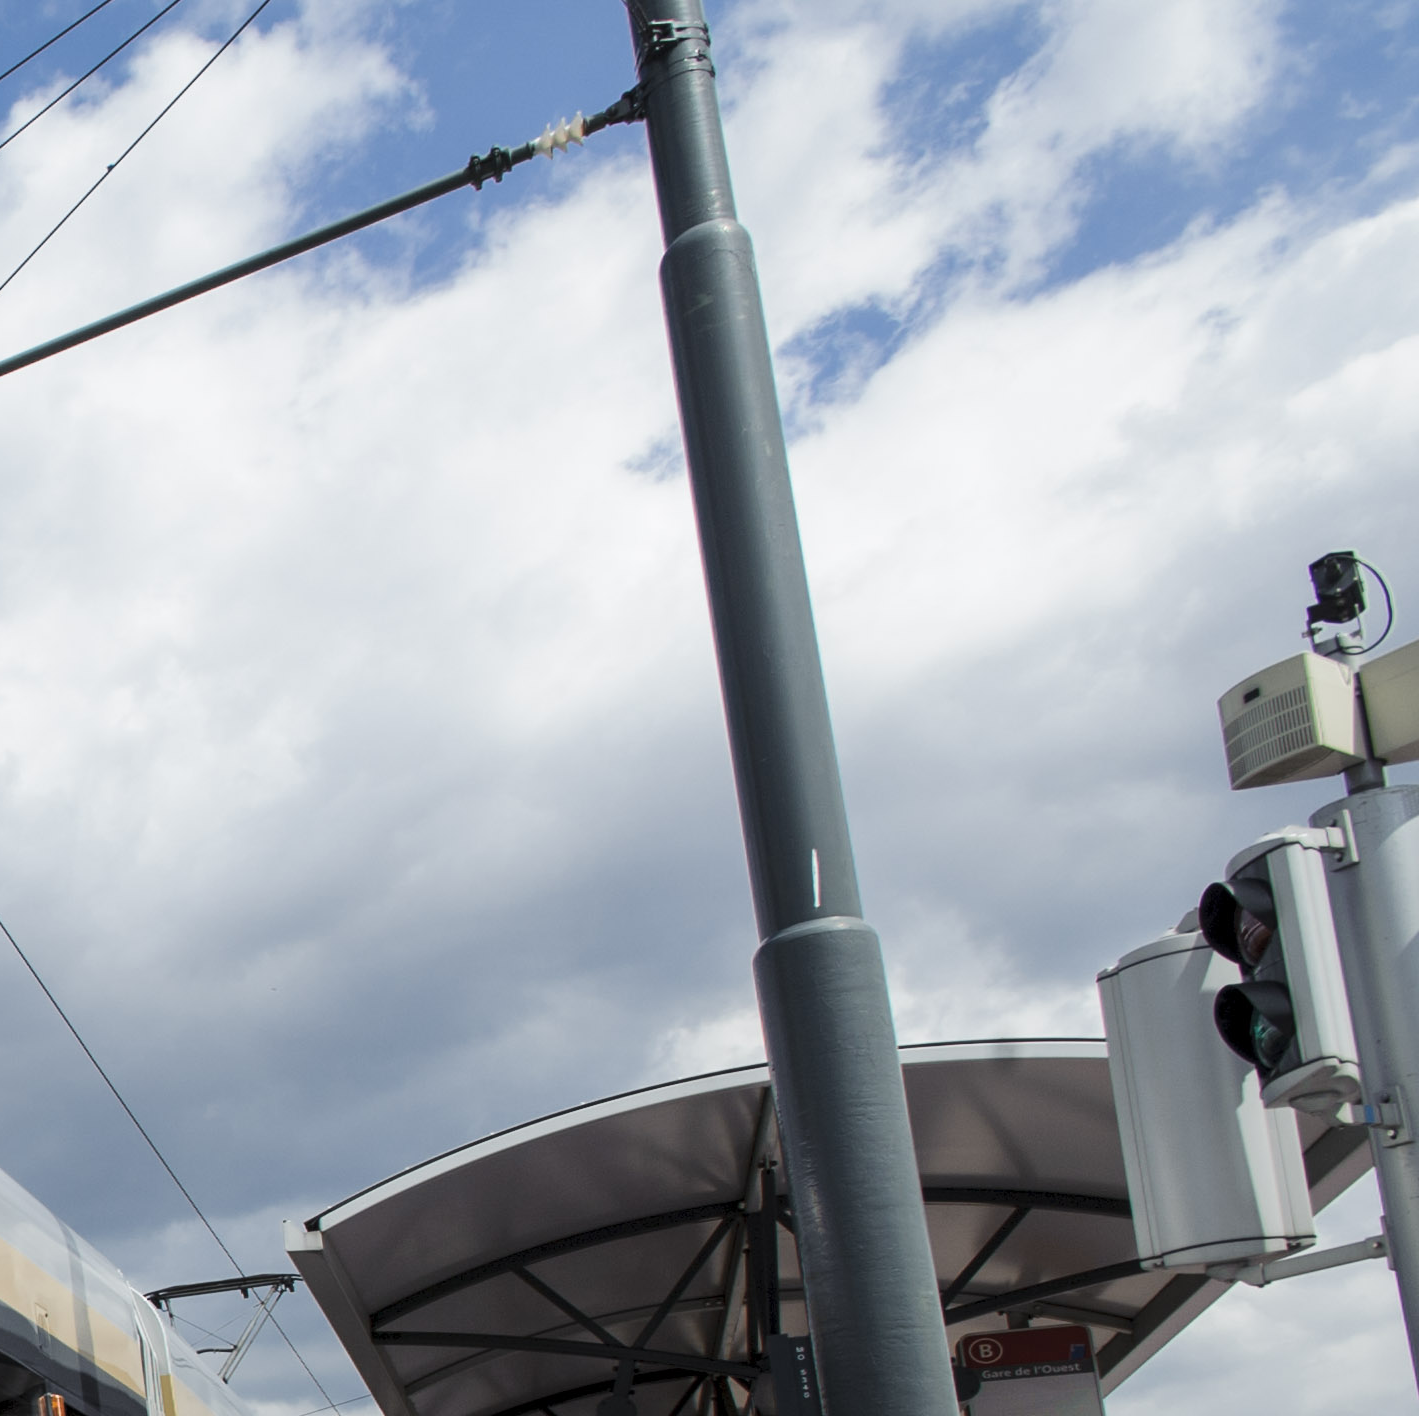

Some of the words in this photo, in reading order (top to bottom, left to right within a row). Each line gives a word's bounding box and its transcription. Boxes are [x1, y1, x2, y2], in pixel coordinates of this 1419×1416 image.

[982, 1369, 1012, 1379] Gare
[1015, 1365, 1031, 1376] de
[1034, 1362, 1082, 1375] l'Ouest
